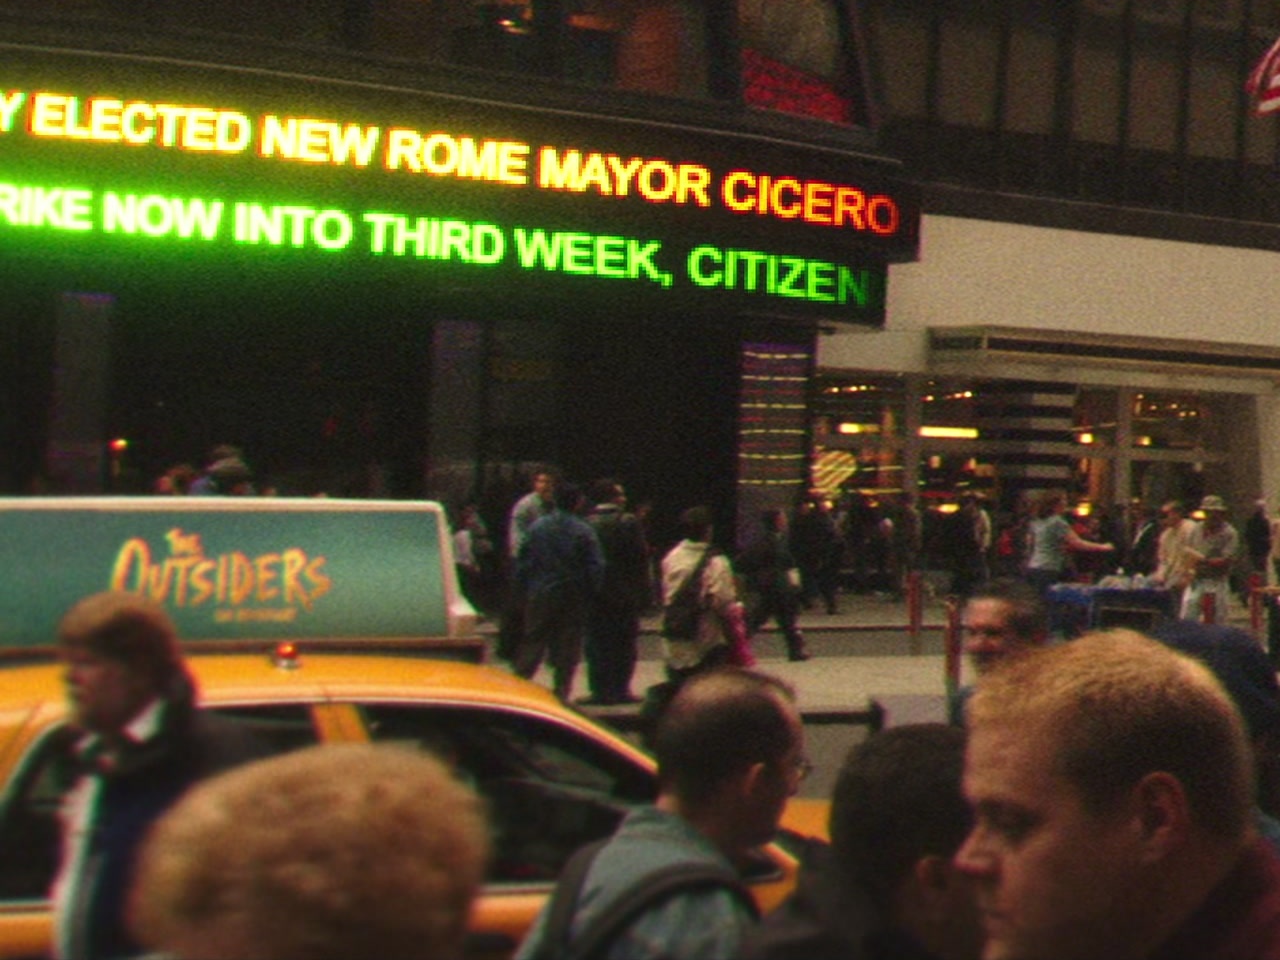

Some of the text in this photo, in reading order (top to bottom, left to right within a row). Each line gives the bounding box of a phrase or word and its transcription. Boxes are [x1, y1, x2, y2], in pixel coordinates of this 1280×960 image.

[30, 91, 251, 153] ELECTED
[260, 113, 379, 167] NEW
[385, 128, 530, 186] ROME
[537, 145, 711, 208] MAYOR
[721, 168, 900, 236] CICERO
[102, 191, 225, 241] NOW
[233, 201, 355, 252] INTO
[362, 211, 505, 265] THIRD
[512, 227, 673, 290] WEEK,
[685, 243, 871, 307] CITIZEN
[110, 537, 333, 612] OUTSIDERS
